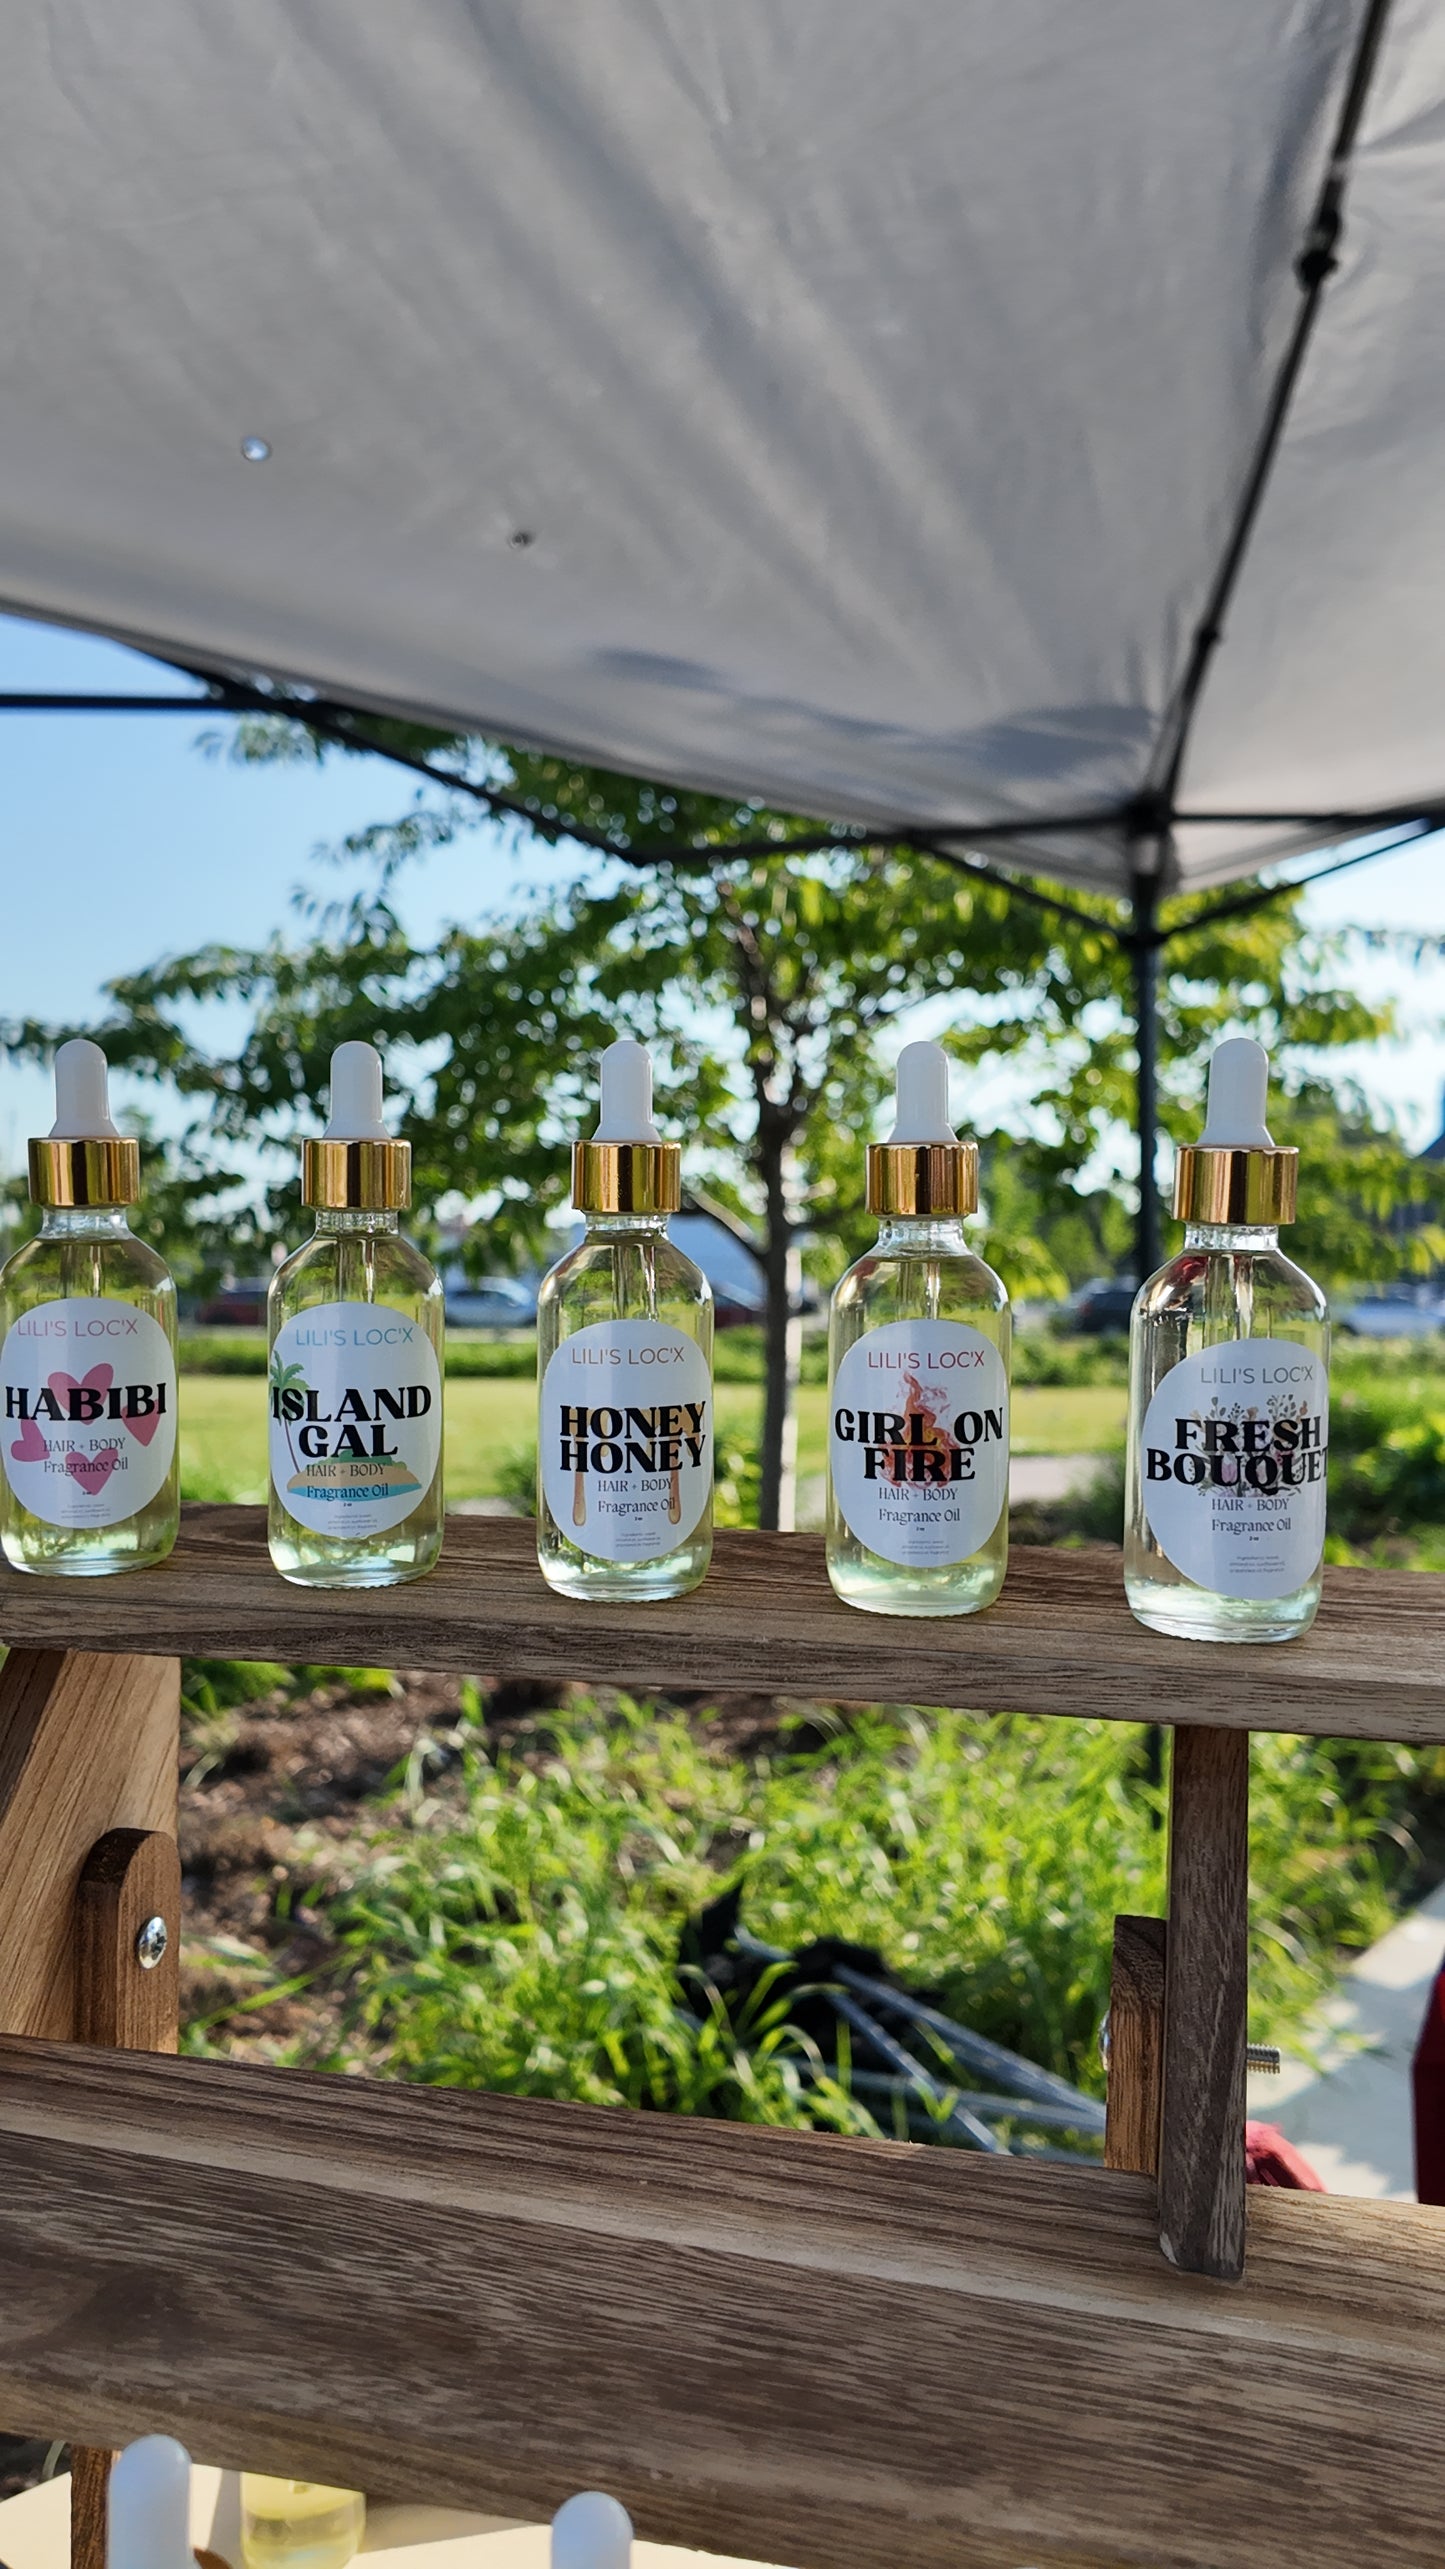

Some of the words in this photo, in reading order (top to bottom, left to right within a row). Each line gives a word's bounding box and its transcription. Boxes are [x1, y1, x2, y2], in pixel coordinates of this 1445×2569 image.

[17, 1319, 67, 1337] LILI'S
[75, 1318, 138, 1337] LOC'X
[296, 1329, 346, 1346] LILI'S
[354, 1327, 414, 1345] LOC'X
[572, 1348, 621, 1365] LILI'S
[628, 1347, 685, 1365] LOC'X
[868, 1351, 920, 1369] LILI'S
[928, 1350, 985, 1369] LOC'X
[1200, 1367, 1255, 1384] LILI'S
[1262, 1365, 1313, 1384] LOC'X
[5, 1383, 167, 1421] HABIBI
[272, 1385, 432, 1422] ISLAND
[559, 1400, 706, 1439] HONEY
[835, 1408, 937, 1446] GIRL
[953, 1407, 1004, 1444] ON
[299, 1424, 398, 1458] GAL
[1174, 1415, 1321, 1453] FRESH
[44, 1439, 75, 1452] HAIR
[89, 1437, 126, 1452] BODY
[559, 1434, 706, 1474] HONEY
[44, 1459, 110, 1476] Fragrance
[111, 1457, 128, 1471] Oil
[306, 1464, 337, 1477] HAIR
[350, 1463, 387, 1477] BODY
[863, 1447, 976, 1482] FIRE
[306, 1484, 369, 1501] Fragrance
[371, 1482, 389, 1497] Oil
[598, 1479, 628, 1492] HAIR
[641, 1478, 674, 1491] BODY
[879, 1488, 909, 1501] HAIR
[923, 1487, 958, 1501] BODY
[598, 1500, 659, 1516] Fragrance
[660, 1496, 675, 1511] Oil
[1212, 1499, 1243, 1511] HAIR
[1257, 1498, 1290, 1511] BODY
[879, 1509, 942, 1526] Fragrance
[944, 1507, 960, 1522] Oil
[1212, 1519, 1275, 1535] Fragrance
[1276, 1517, 1291, 1531] Oil
